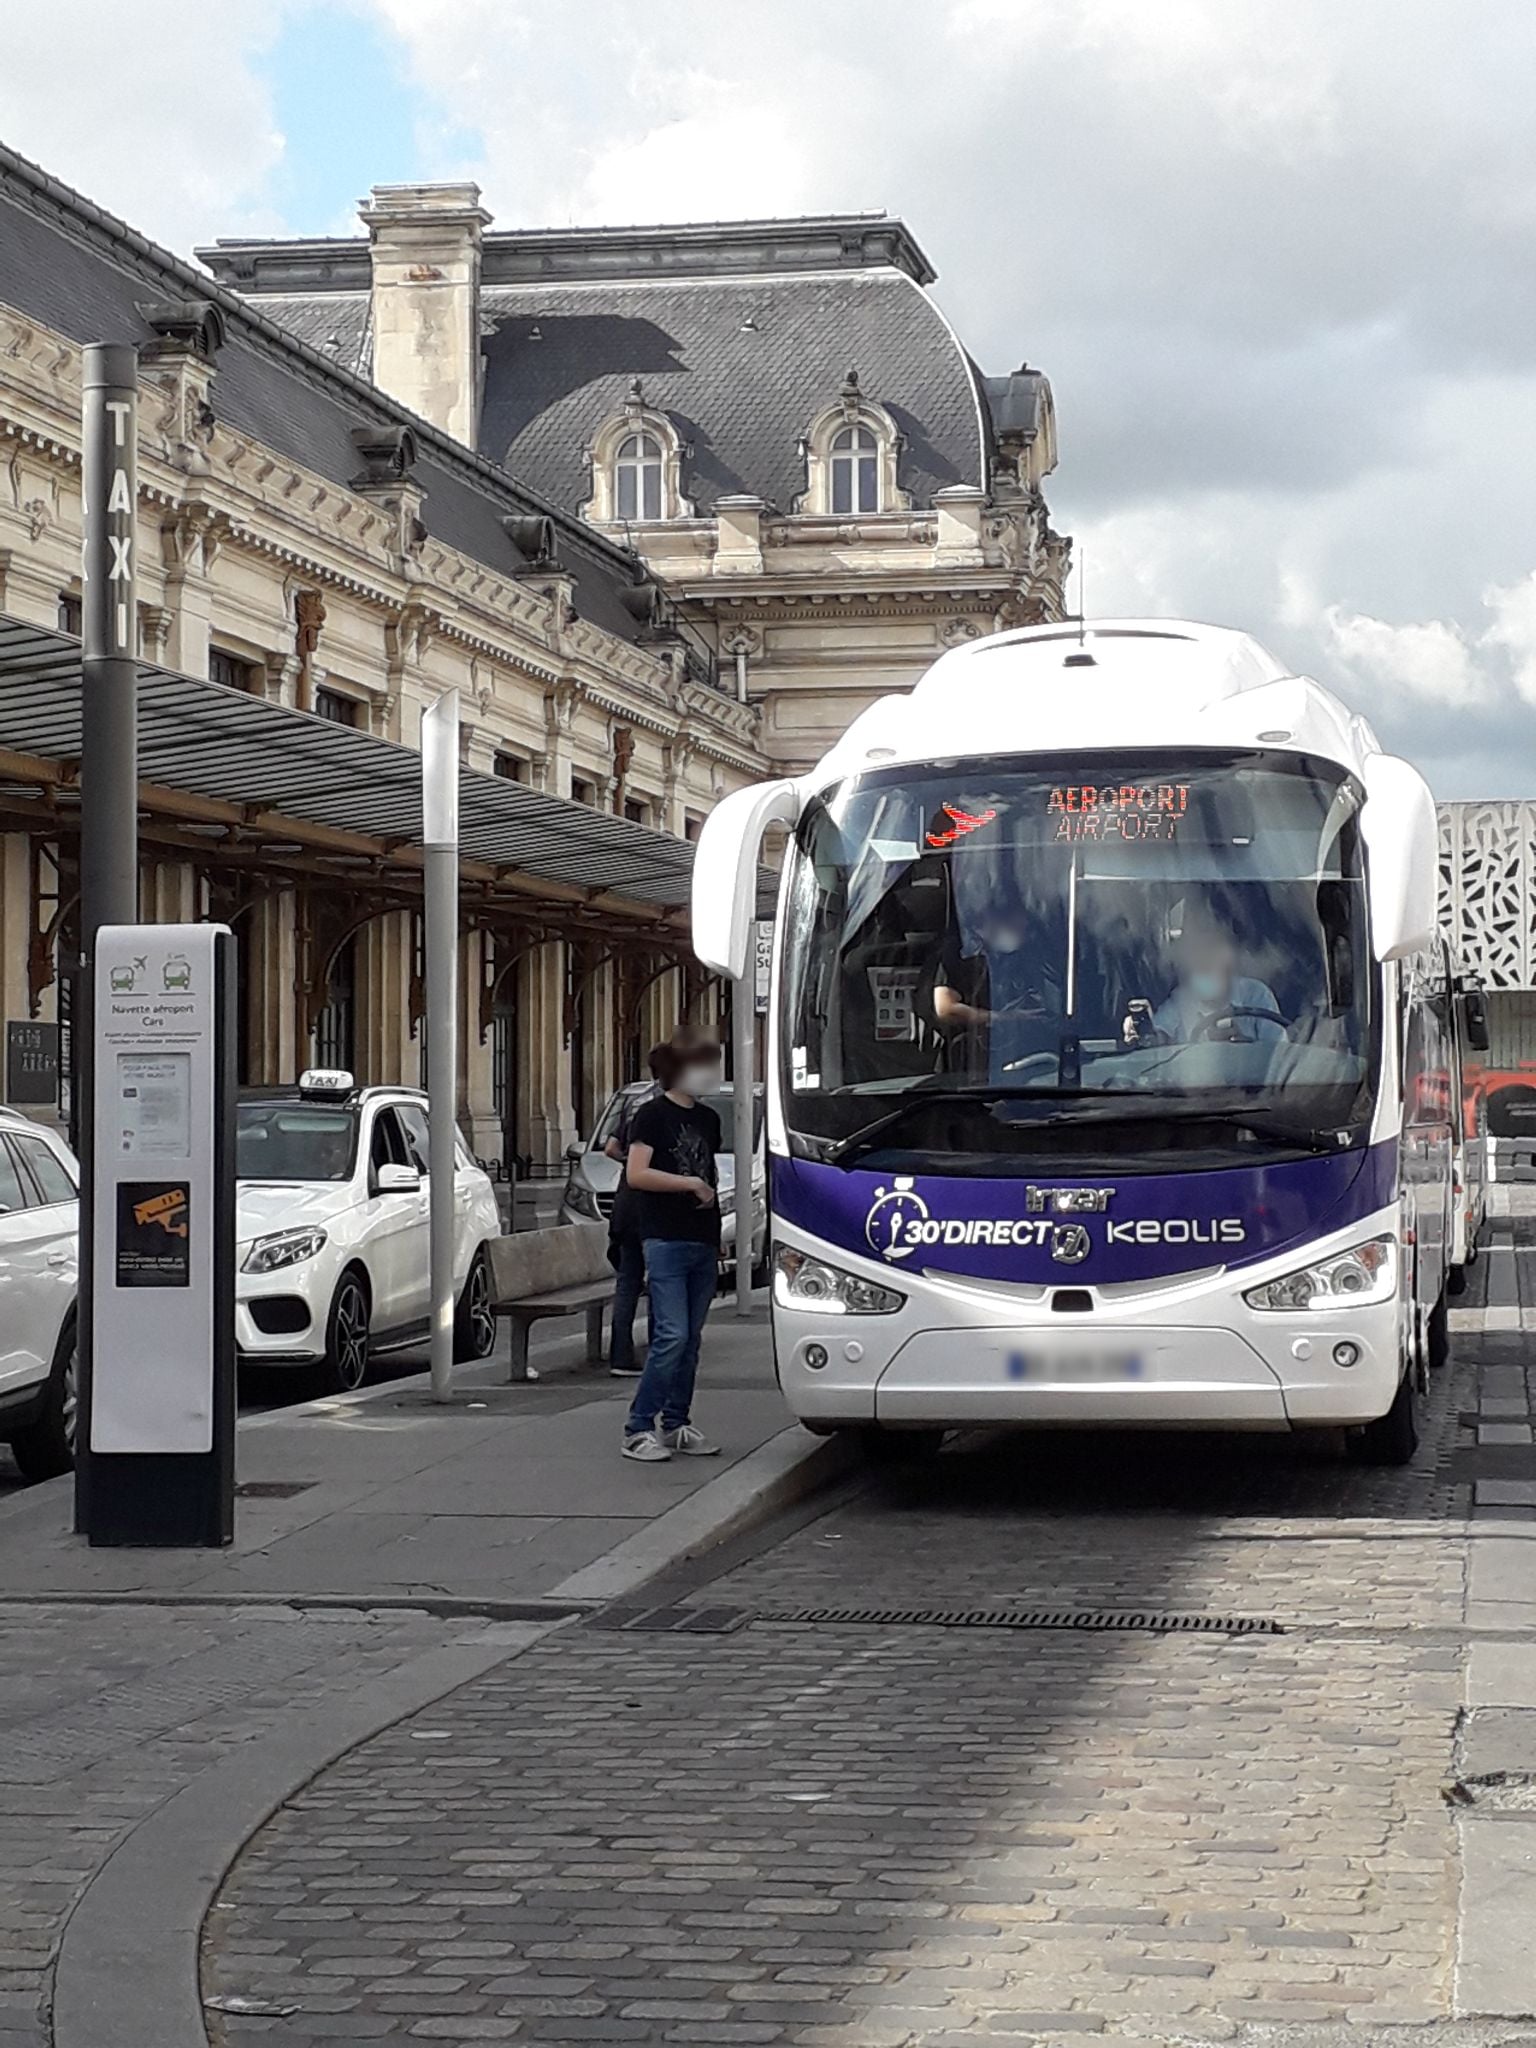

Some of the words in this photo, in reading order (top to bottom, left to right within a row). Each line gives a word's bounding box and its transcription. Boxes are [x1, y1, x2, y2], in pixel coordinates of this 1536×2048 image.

[106, 402, 132, 648] TAXI
[1047, 784, 1191, 813] AEROPORT
[1056, 813, 1184, 841] AIRPORT
[142, 1016, 164, 1026] Cars
[308, 1073, 339, 1088] TAXI
[904, 1220, 1053, 1245] 30'DIRECT
